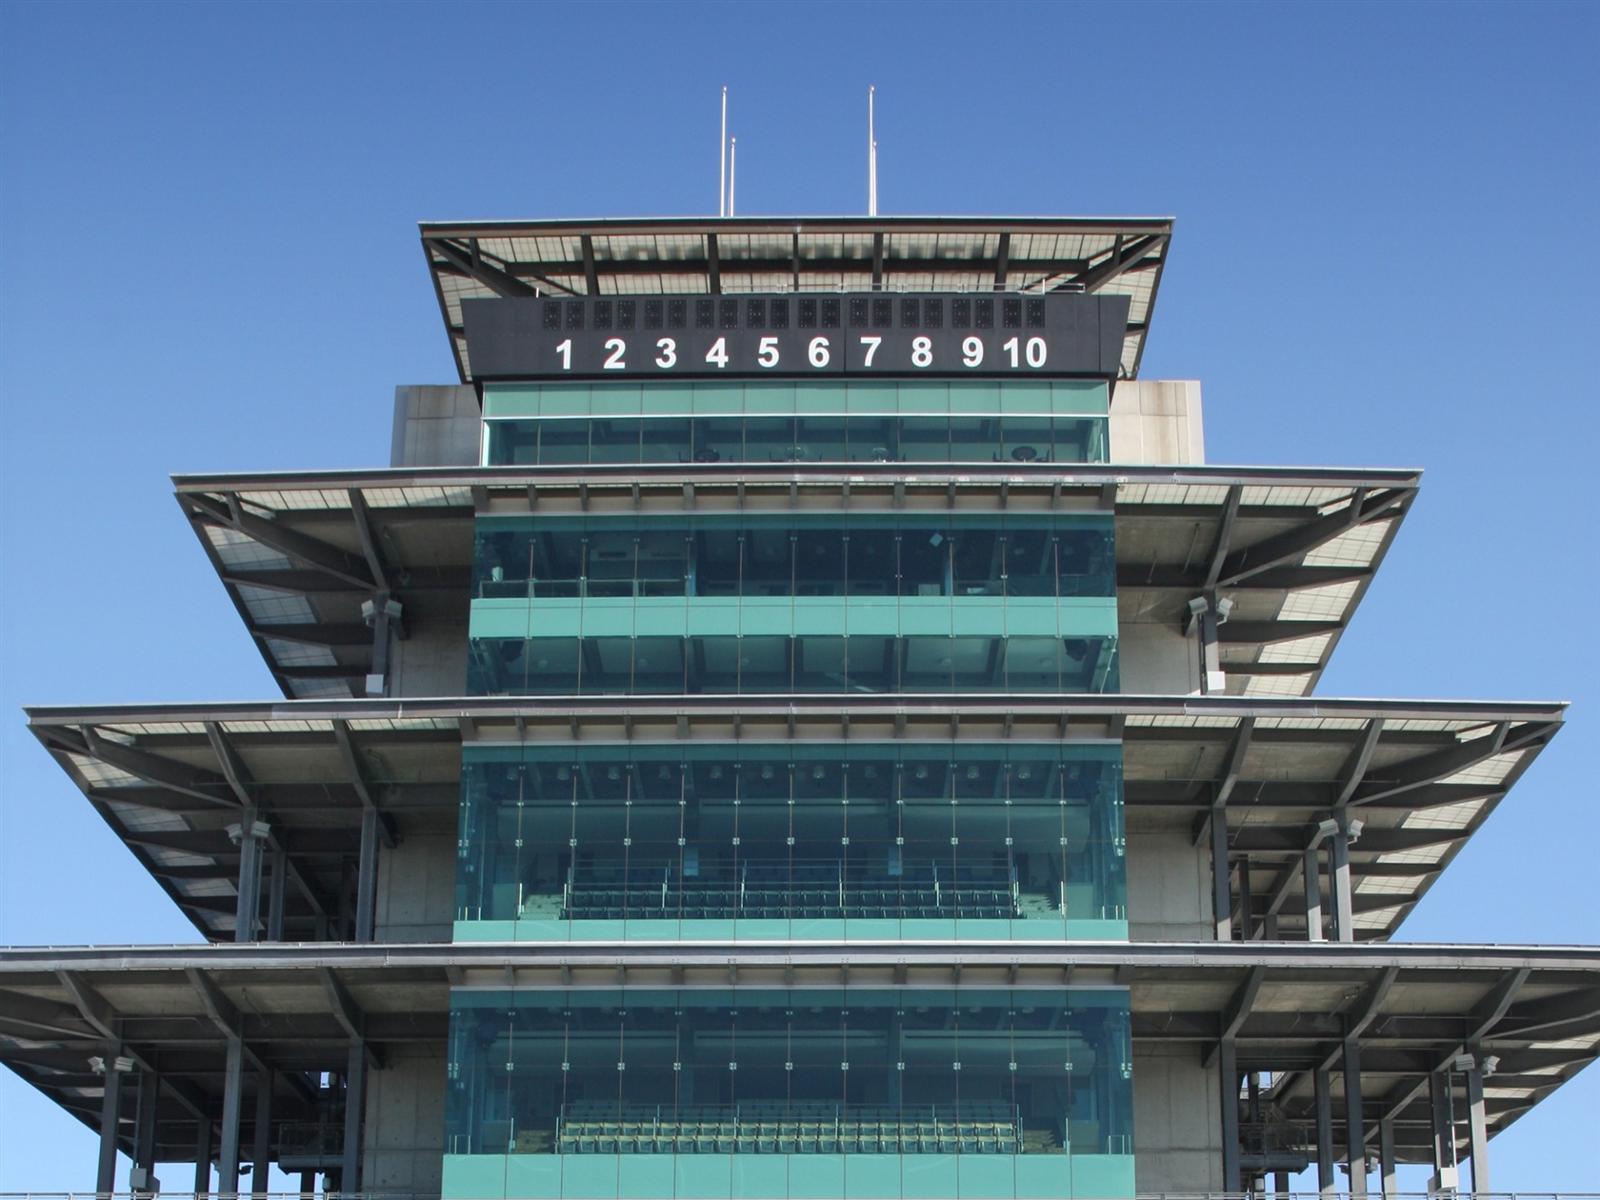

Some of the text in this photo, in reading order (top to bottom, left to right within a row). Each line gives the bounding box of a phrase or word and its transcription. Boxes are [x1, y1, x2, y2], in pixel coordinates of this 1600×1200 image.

[556, 336, 1047, 370] 1 2 3 4 5 6 7 8 9 10
